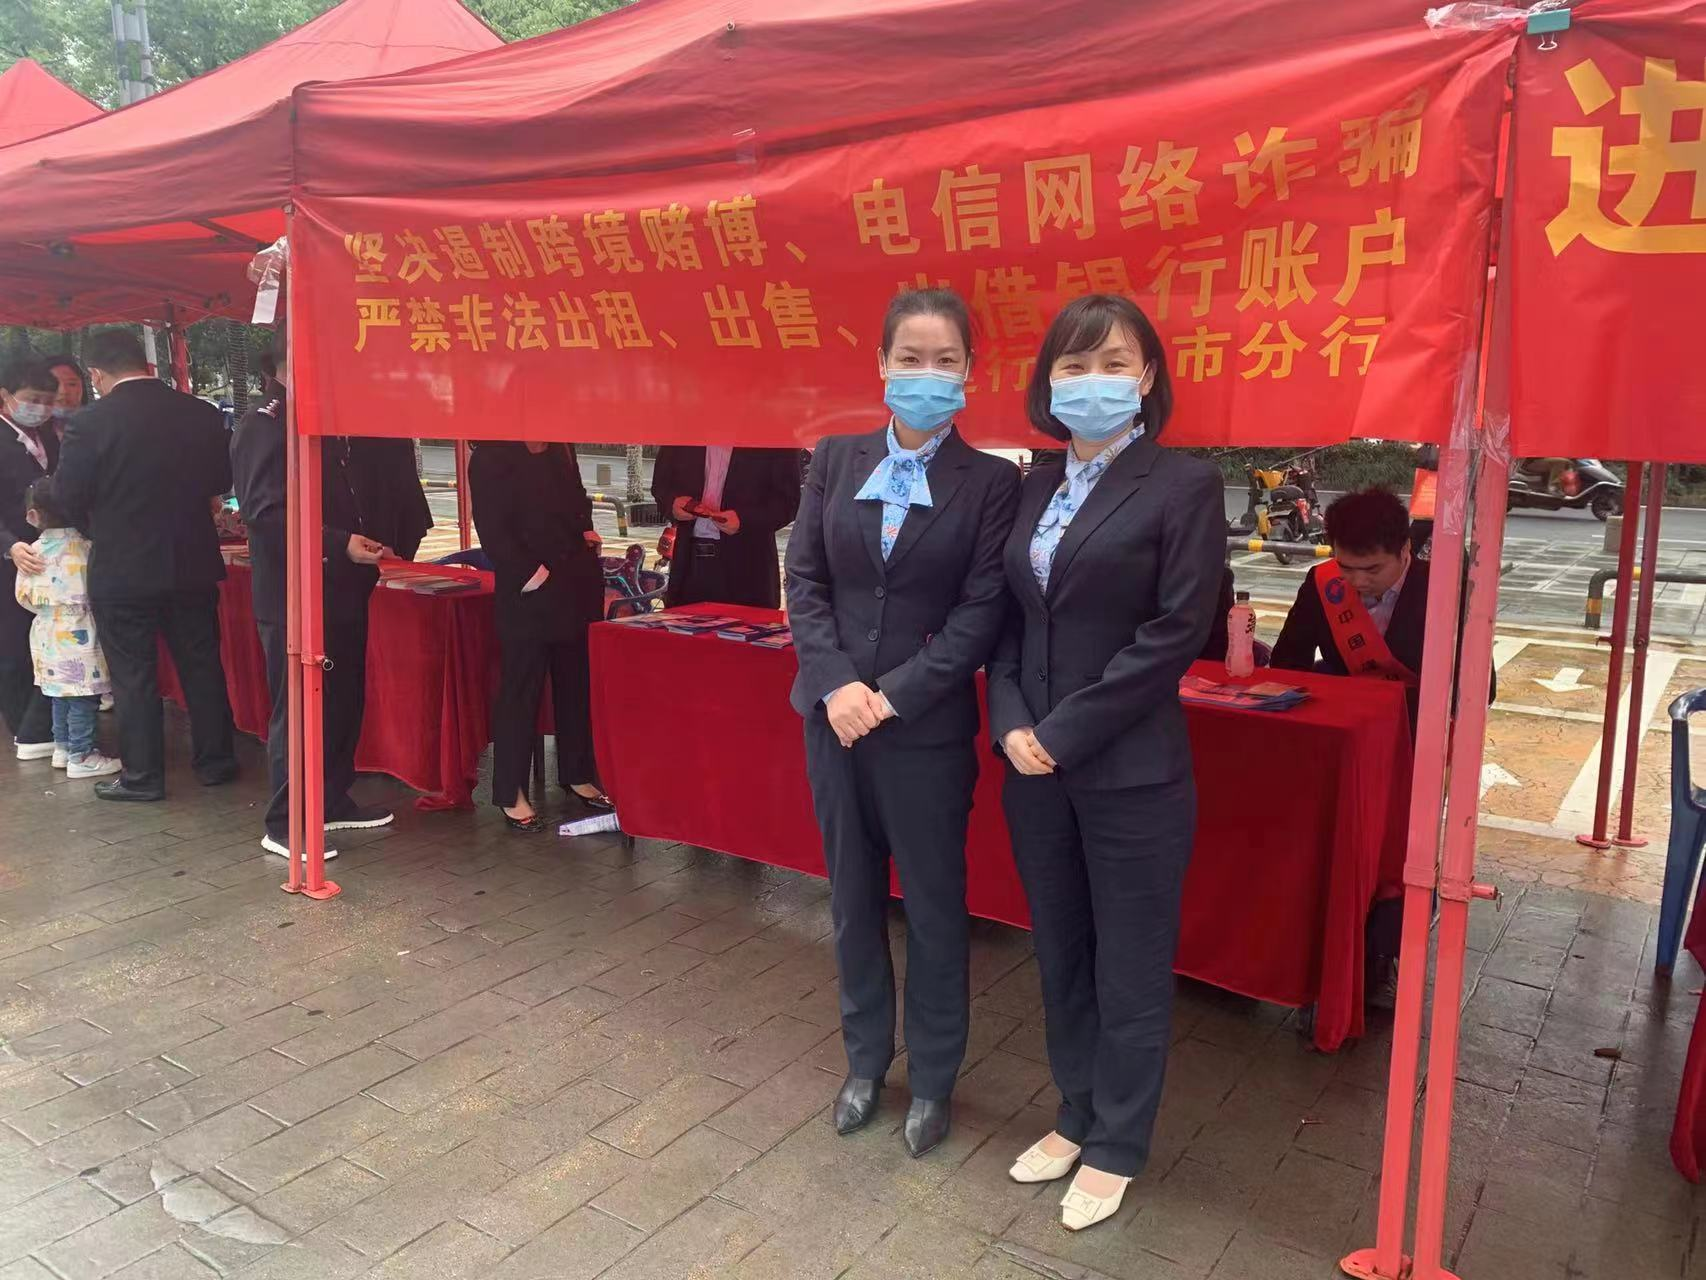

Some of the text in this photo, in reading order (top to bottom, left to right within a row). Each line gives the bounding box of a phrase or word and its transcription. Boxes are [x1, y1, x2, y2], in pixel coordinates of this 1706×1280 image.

[344, 87, 1429, 285] 坚决遏制跨境赌博、电信网络诈骗
[1545, 56, 1706, 257] 进
[355, 207, 1407, 353] 严禁非法出租、出售、借银行账户
